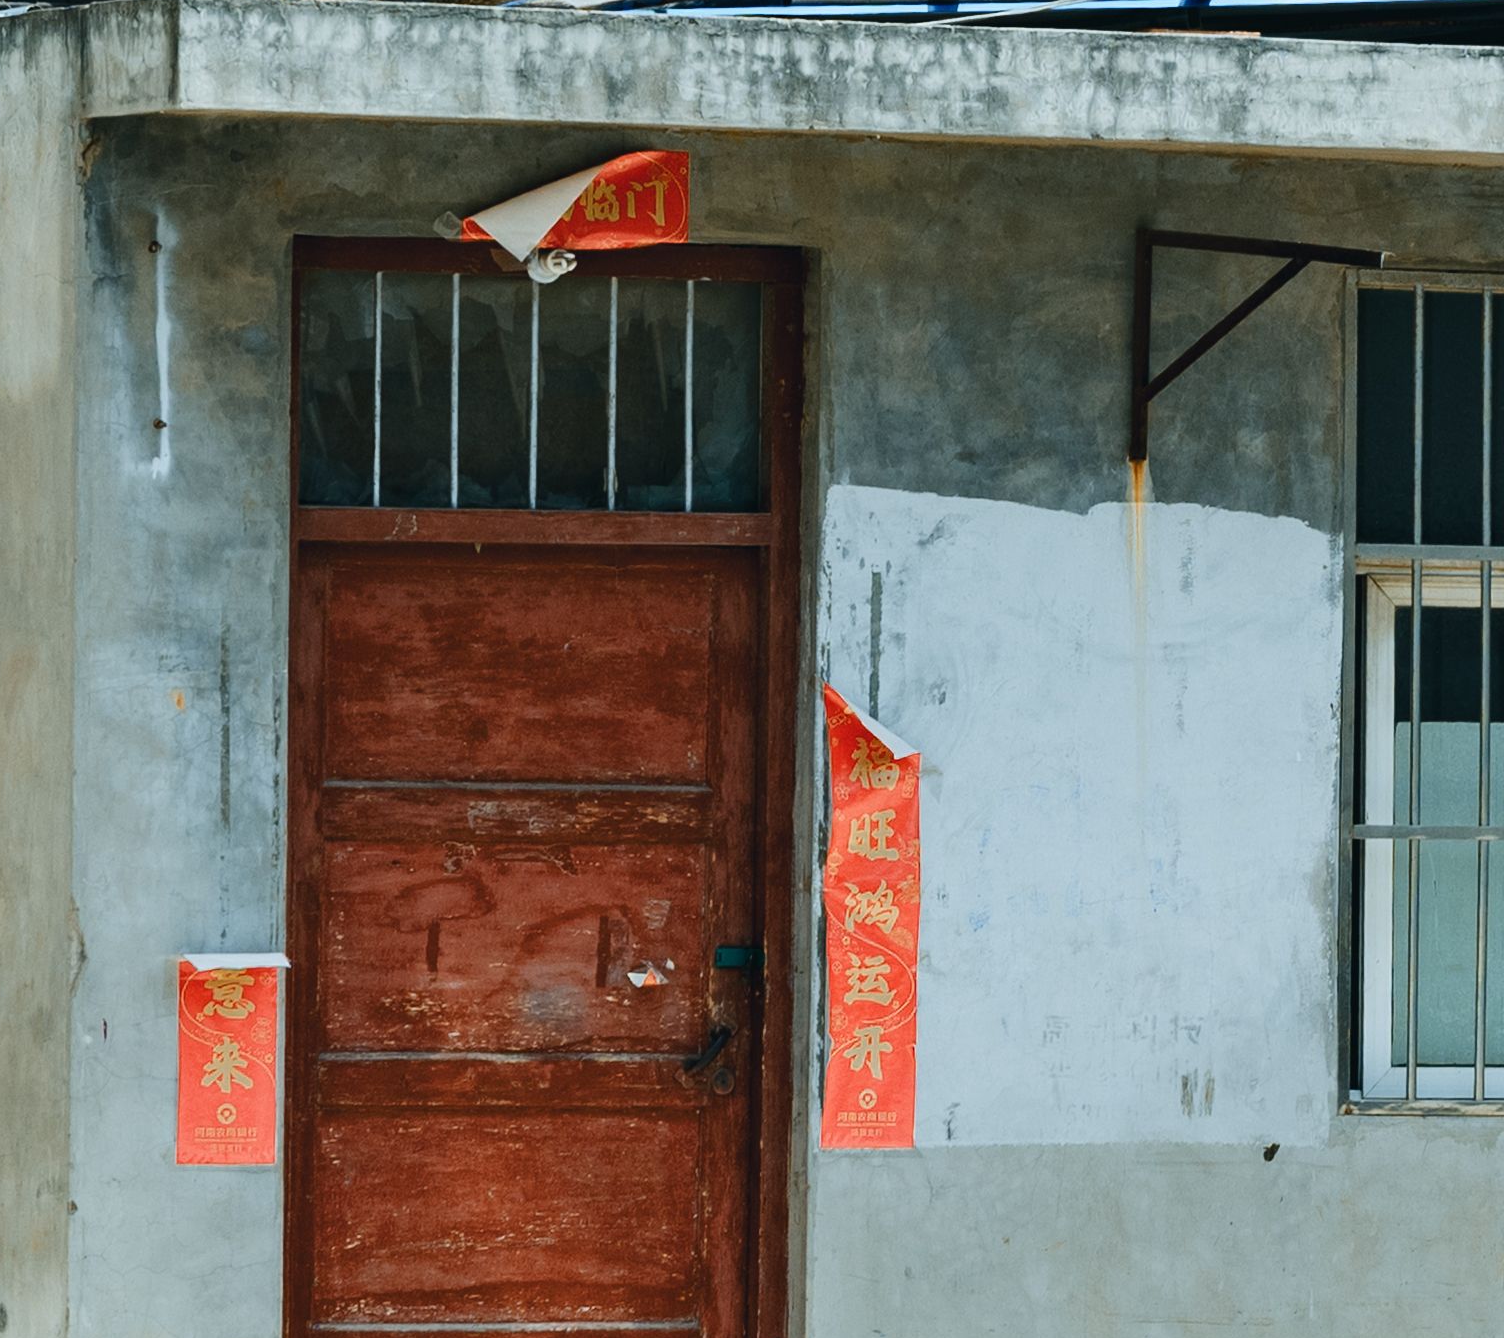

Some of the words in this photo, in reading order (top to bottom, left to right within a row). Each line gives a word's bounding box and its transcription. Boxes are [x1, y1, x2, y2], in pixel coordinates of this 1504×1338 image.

[563, 178, 666, 227] 临门
[842, 737, 901, 1080] 福旺鸿运开
